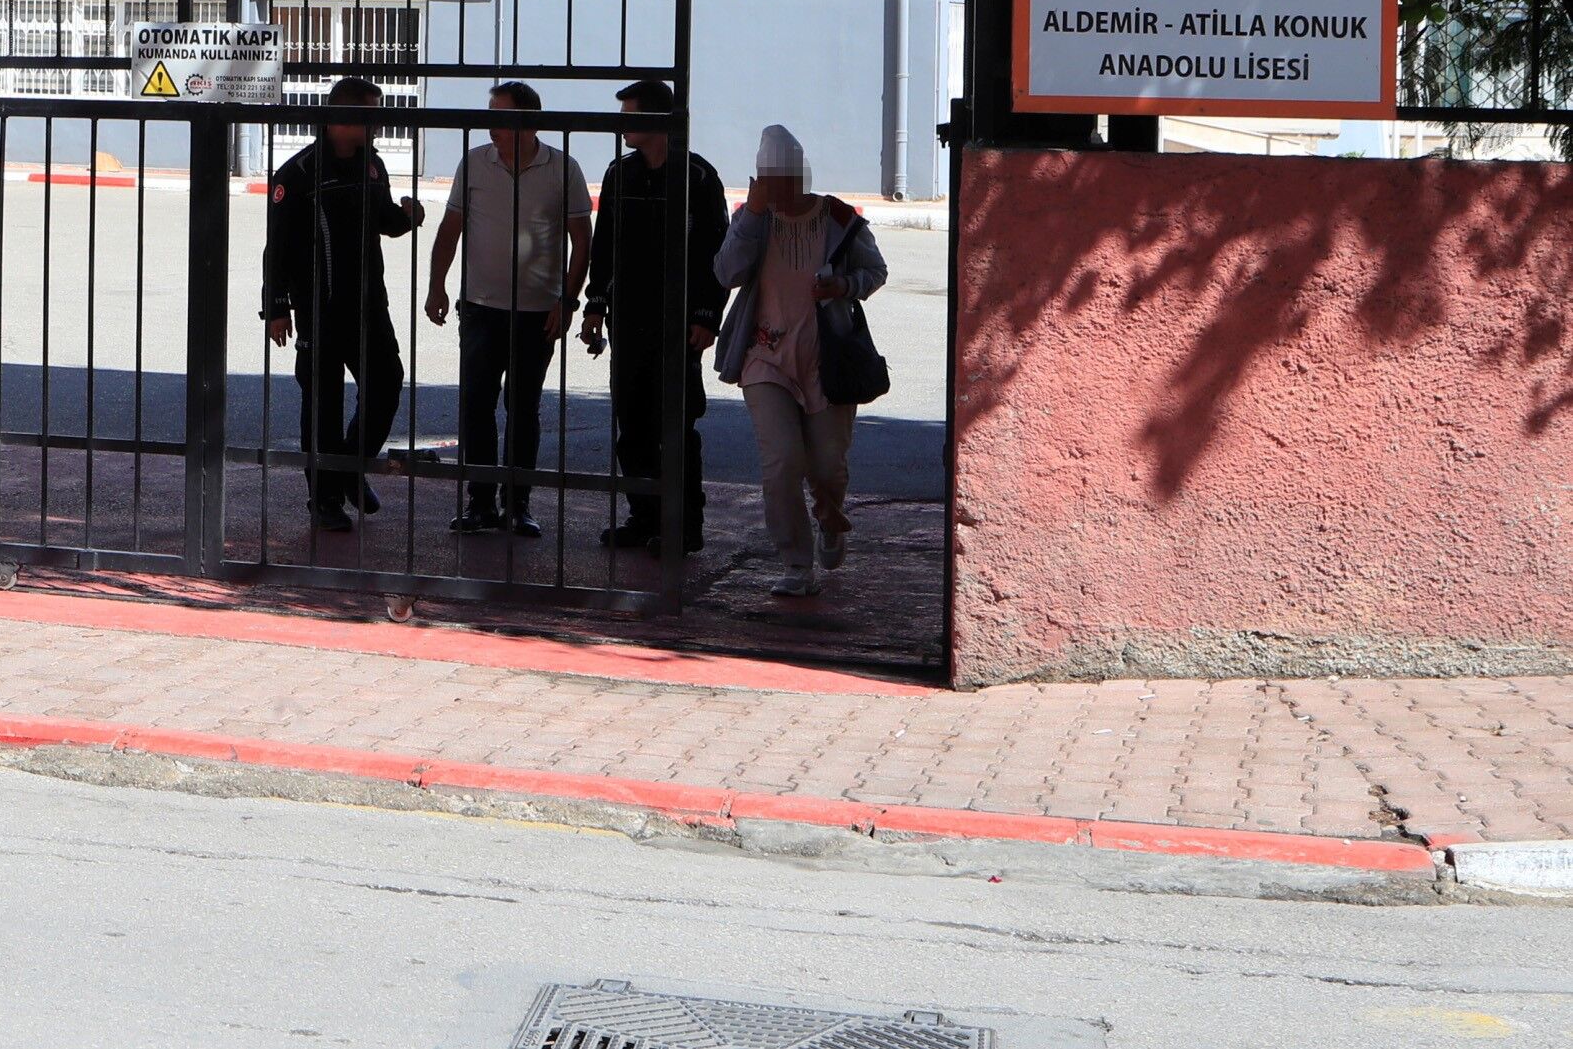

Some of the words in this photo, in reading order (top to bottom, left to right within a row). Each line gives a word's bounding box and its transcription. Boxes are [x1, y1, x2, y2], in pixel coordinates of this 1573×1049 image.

[138, 25, 231, 45] OTOMATİK
[236, 30, 278, 46] KAPI
[1043, 7, 1158, 35] ALDEMİR
[1180, 9, 1267, 38] ATİLLA
[1274, 16, 1368, 39] KONUK
[138, 48, 196, 60] KUMANDA
[200, 49, 278, 61] KULLANINIZ!
[1099, 54, 1227, 79] ANADOLU
[1234, 52, 1310, 81] LİSESİ
